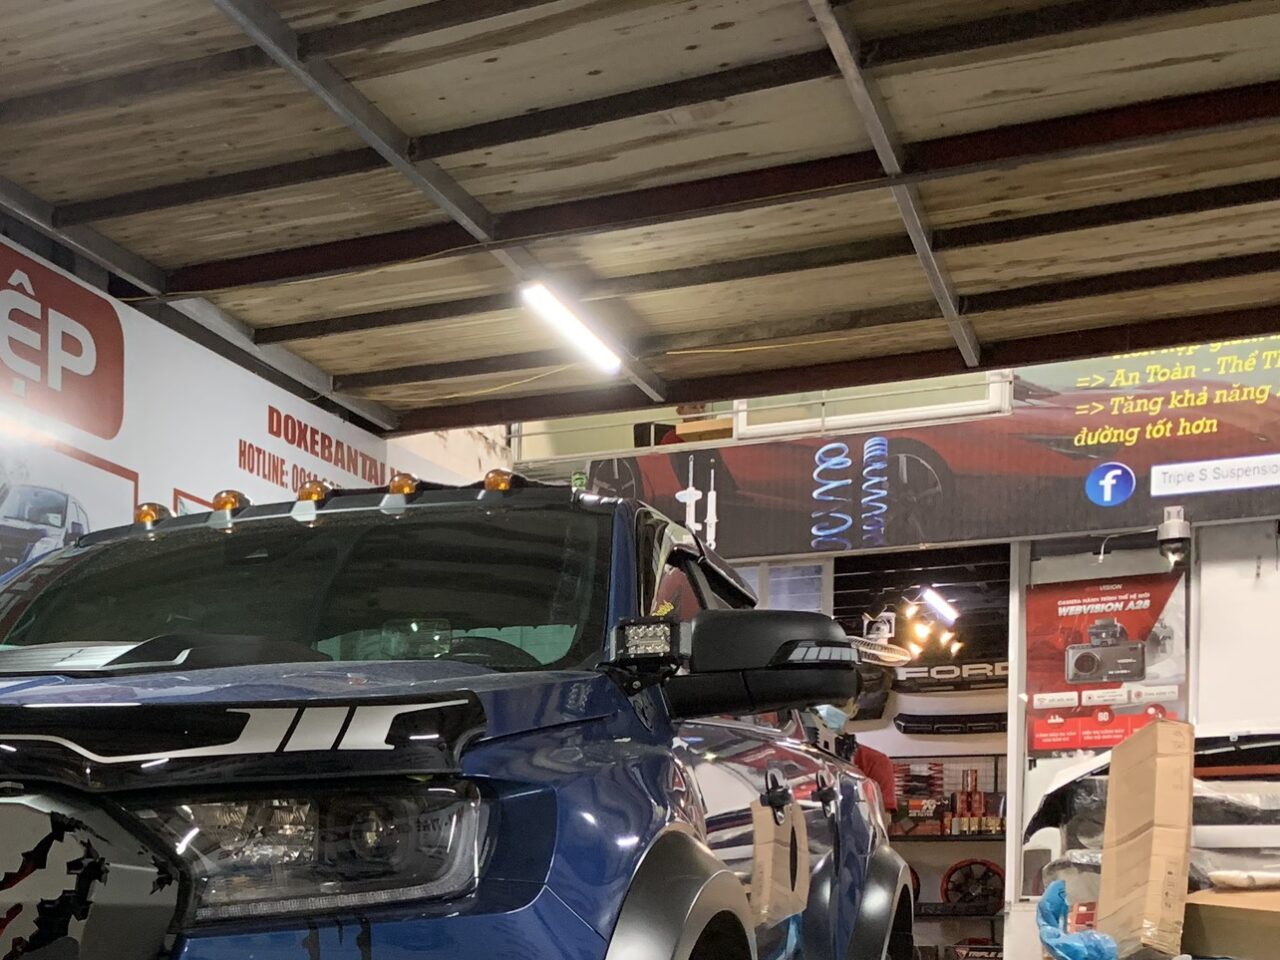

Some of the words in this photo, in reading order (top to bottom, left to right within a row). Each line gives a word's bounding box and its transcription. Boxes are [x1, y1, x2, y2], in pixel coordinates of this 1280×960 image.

[1109, 368, 1140, 388] An
[1146, 362, 1197, 384] Toàn
[1110, 395, 1164, 416] Tăng
[1168, 385, 1209, 409] khả
[1213, 383, 1272, 405] năng
[1073, 426, 1140, 447] đường
[1145, 417, 1173, 440] tốt
[1176, 416, 1218, 437] hơn
[238, 438, 289, 489] HOTLINE:
[1199, 467, 1208, 481] S
